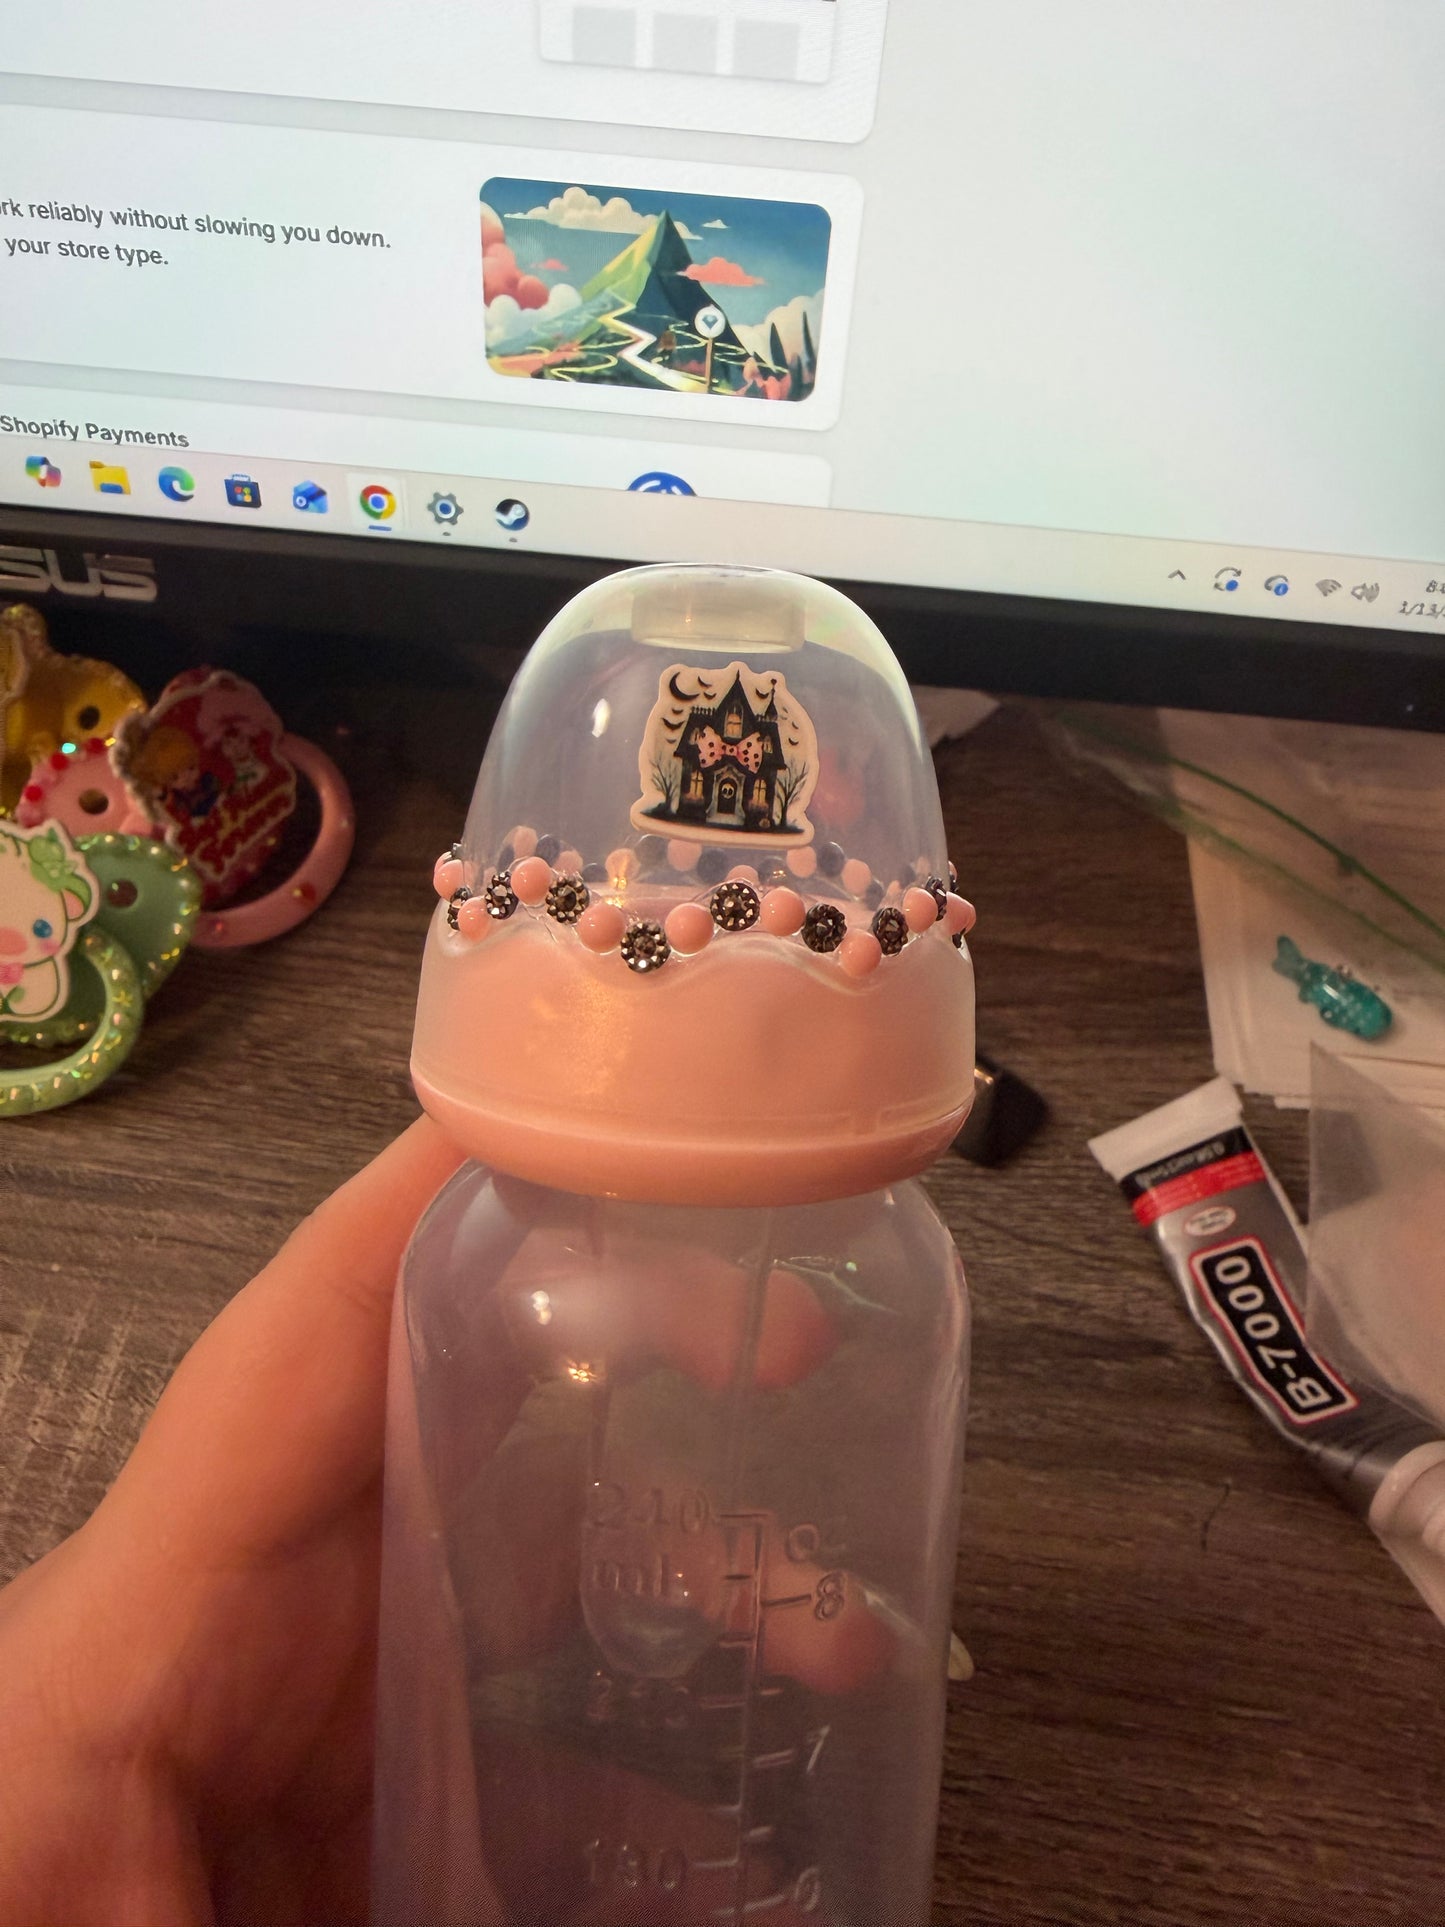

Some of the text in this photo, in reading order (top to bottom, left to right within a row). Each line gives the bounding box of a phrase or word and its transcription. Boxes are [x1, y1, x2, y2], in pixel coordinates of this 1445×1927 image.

[0, 198, 392, 249] rk reliably without slowing you down.
[4, 238, 169, 268] your store type.
[0, 415, 190, 447] Shopify Payments
[1399, 600, 1445, 620] 1/13/
[1214, 1256, 1333, 1409] B-7000
[815, 1570, 847, 1622] 8
